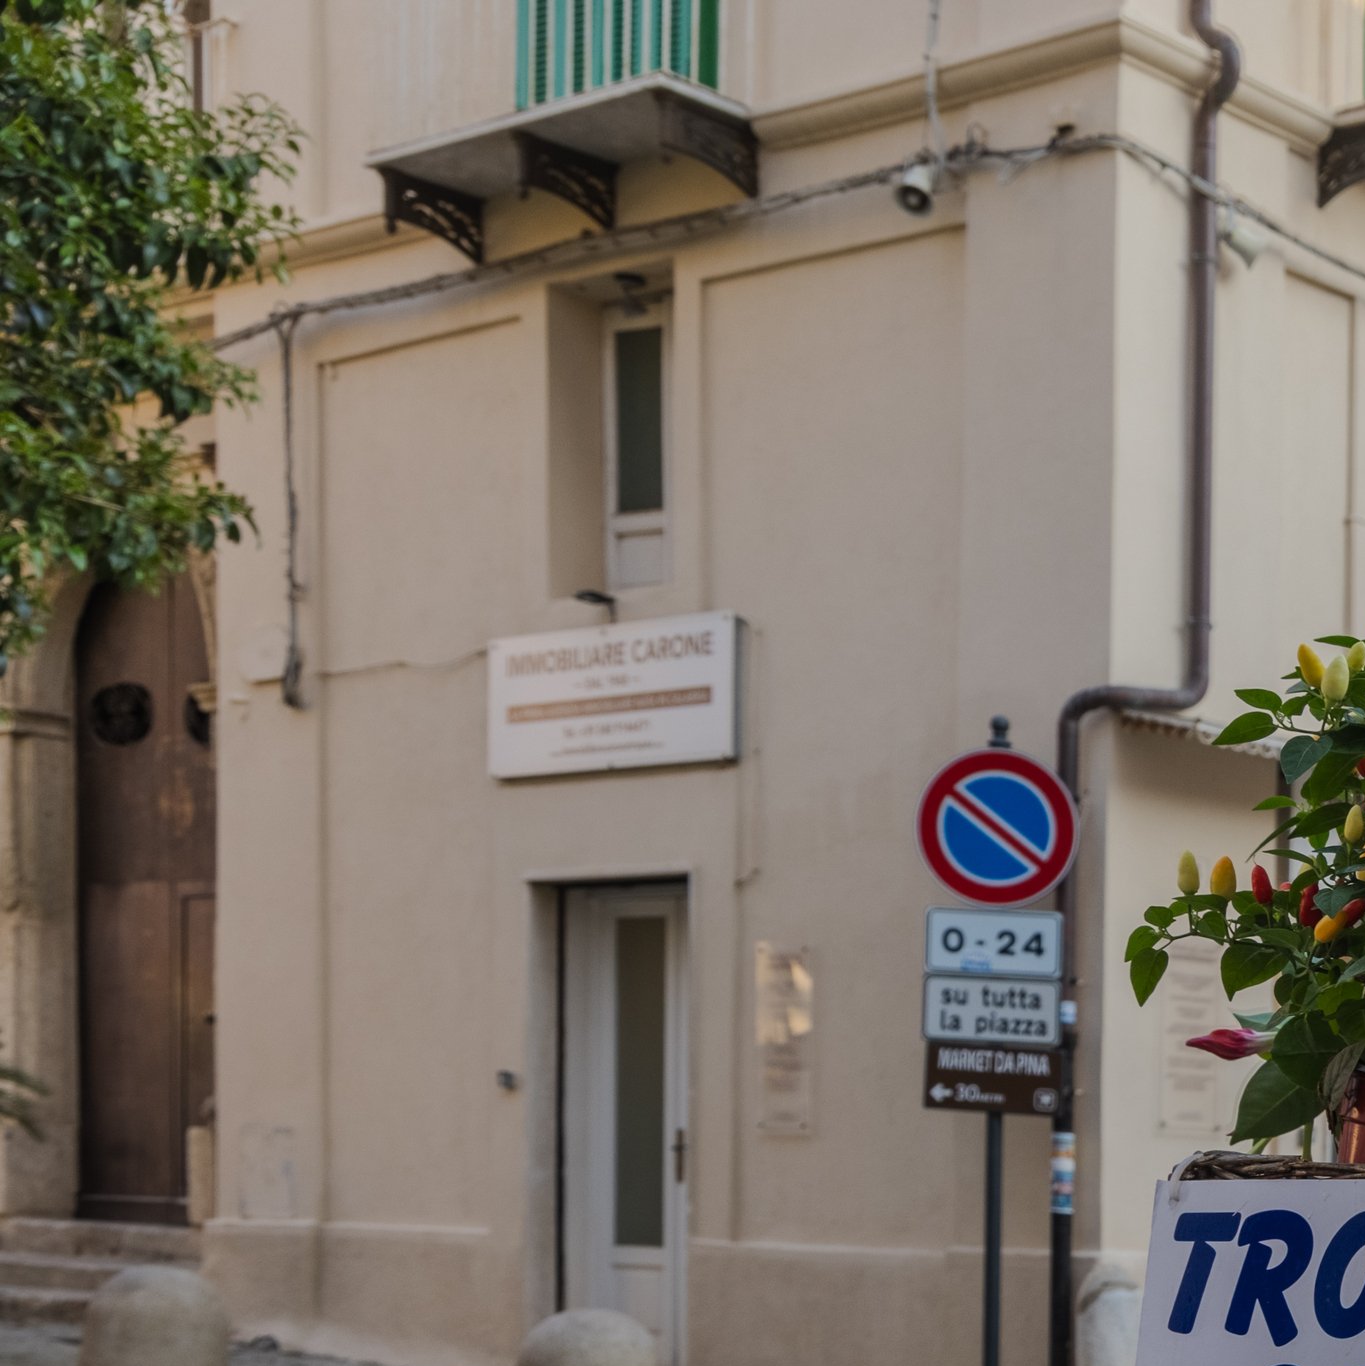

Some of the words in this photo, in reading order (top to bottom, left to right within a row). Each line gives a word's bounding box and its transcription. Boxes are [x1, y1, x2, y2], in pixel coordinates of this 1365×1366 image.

[507, 642, 625, 677] IMMOBILIARE
[630, 631, 714, 663] CARONE
[997, 930, 1044, 957] 24
[941, 987, 968, 1005] su
[981, 985, 1041, 1009] tutta
[940, 1009, 961, 1031] la
[975, 1012, 1047, 1037] piazza
[937, 1047, 993, 1072] MARKET
[994, 1051, 1015, 1075] DA
[1016, 1053, 1051, 1077] PINA
